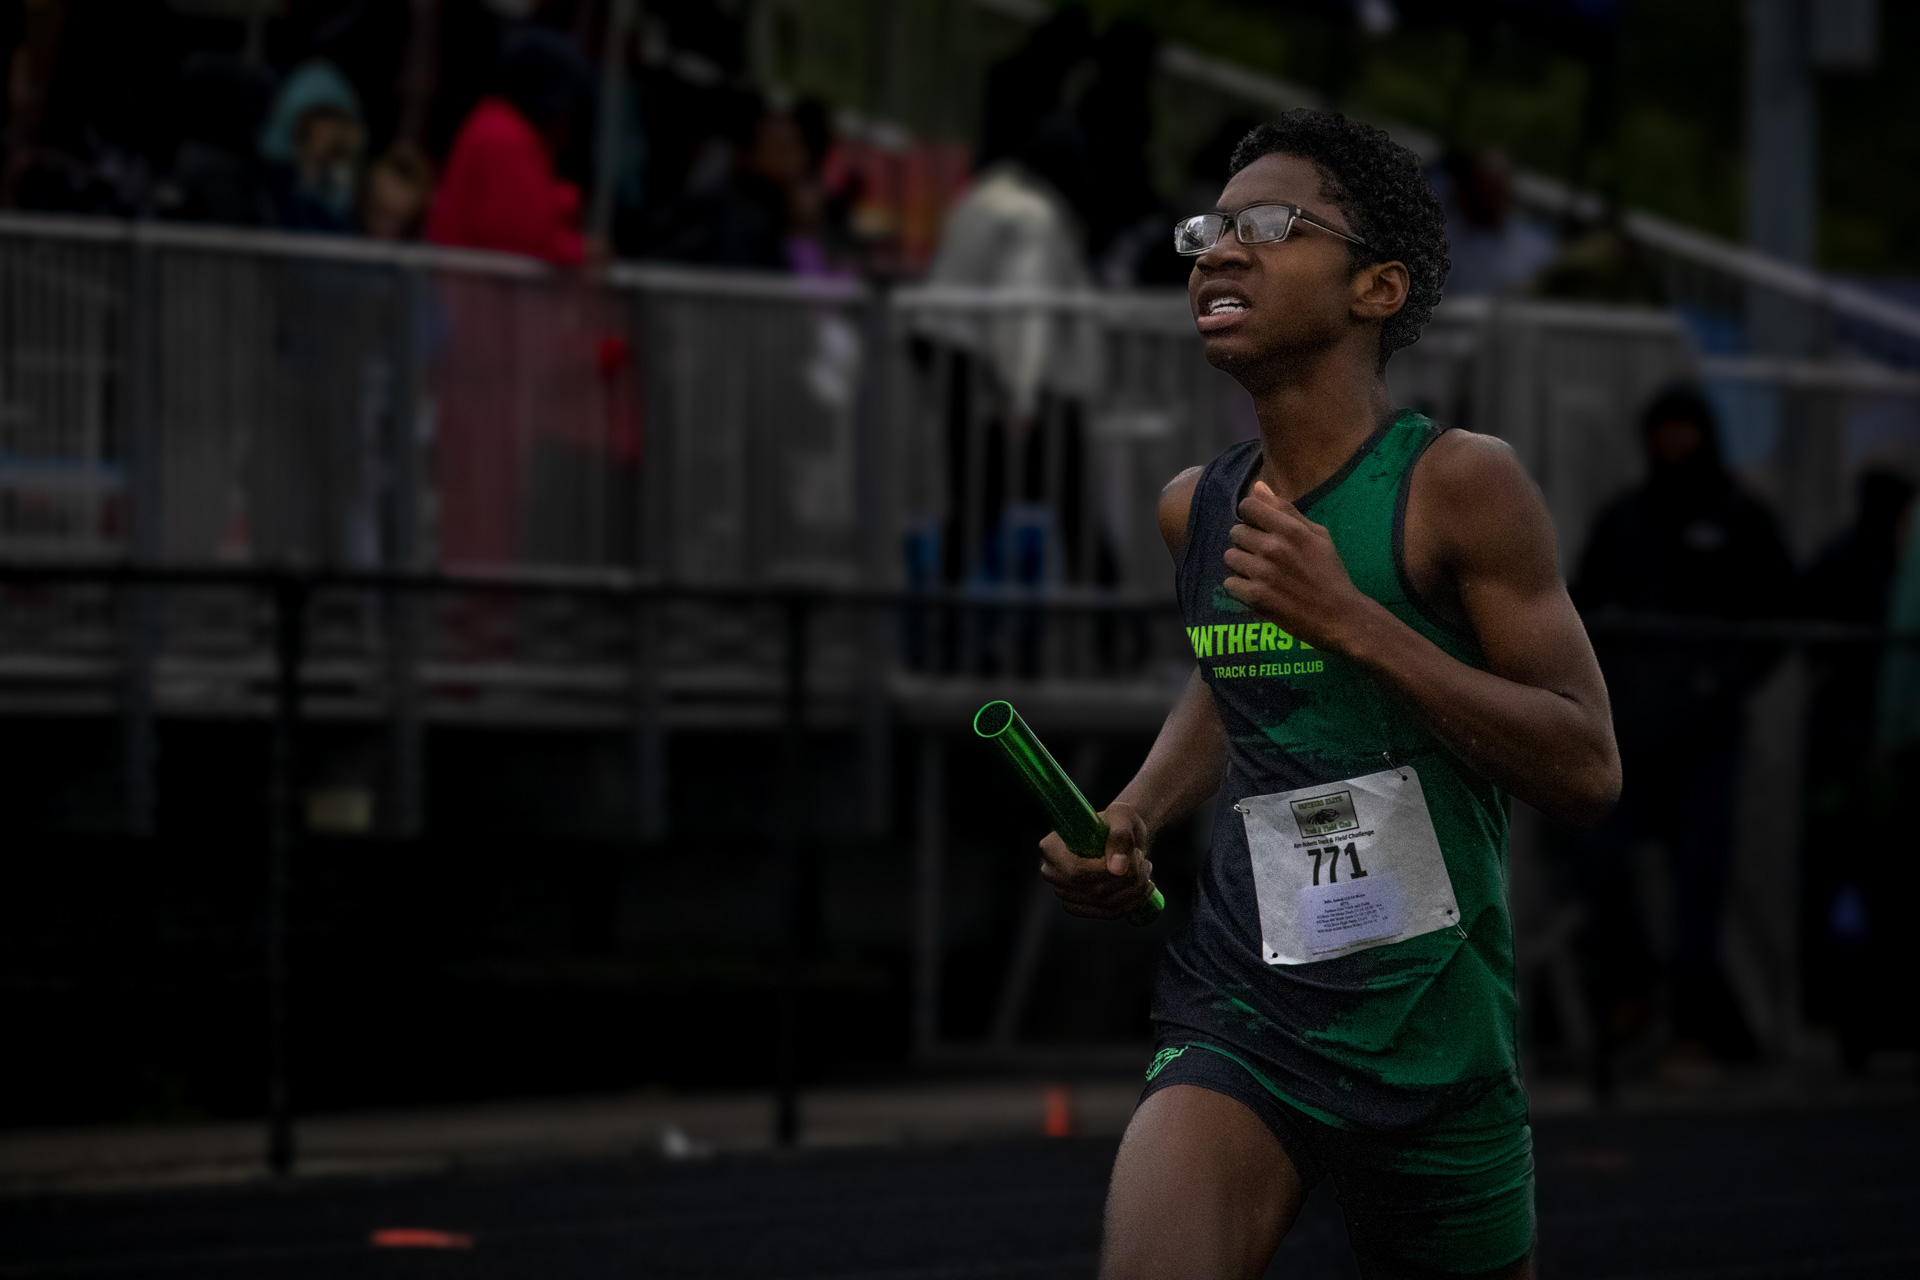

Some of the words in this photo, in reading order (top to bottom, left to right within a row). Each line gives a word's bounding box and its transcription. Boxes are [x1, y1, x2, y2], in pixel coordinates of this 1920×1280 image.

[1186, 622, 1294, 658] ANTHERS
[1212, 665, 1246, 679] TRACK
[1248, 664, 1256, 677] &
[1259, 662, 1291, 676] FIELD
[1293, 660, 1324, 674] CLUB
[1348, 829, 1374, 839] Challenge
[1307, 841, 1368, 886] 771
